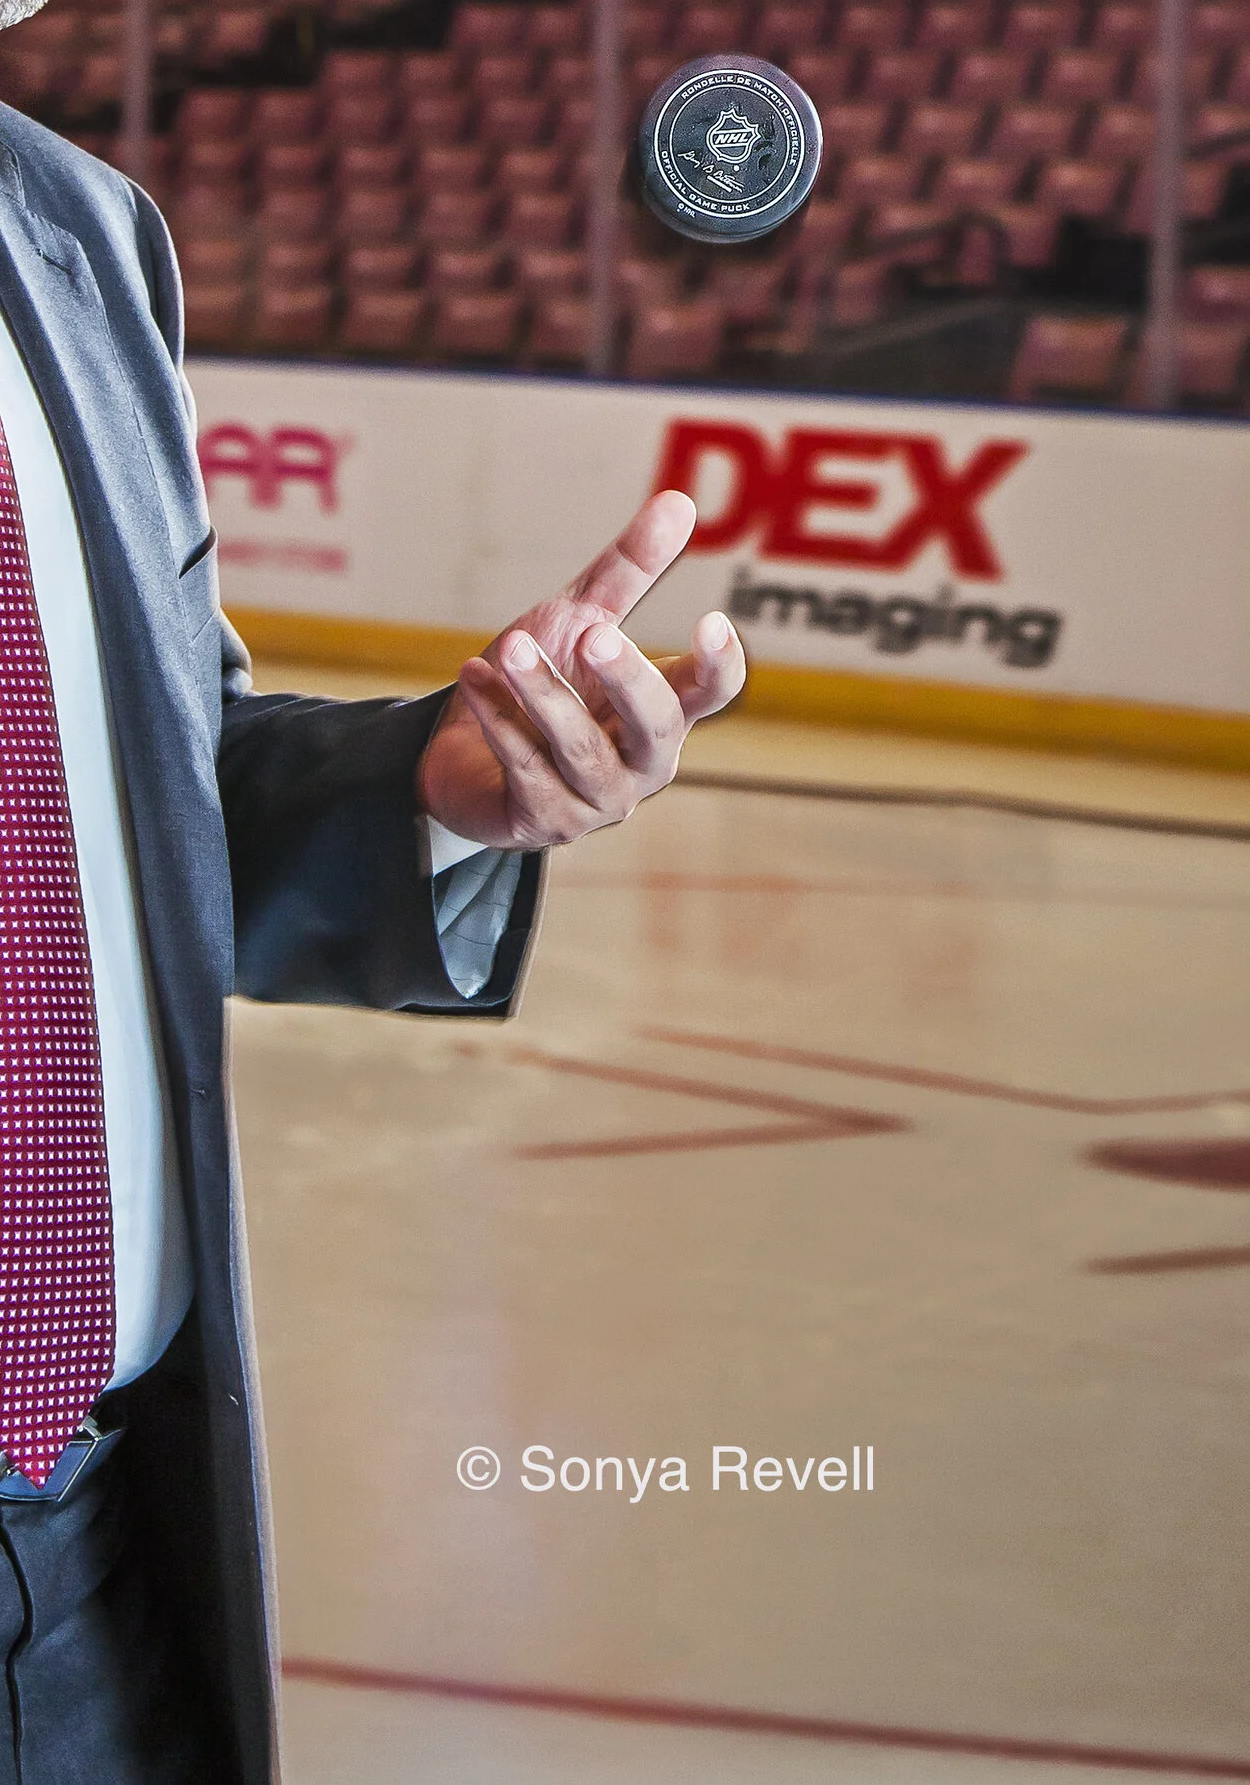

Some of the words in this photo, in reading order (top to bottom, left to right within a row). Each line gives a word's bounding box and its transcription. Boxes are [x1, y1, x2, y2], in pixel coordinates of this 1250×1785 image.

[681, 75, 734, 100] RONDELLE
[737, 76, 752, 86] DE
[754, 81, 784, 107] MATCH
[713, 132, 749, 145] NHL
[661, 151, 687, 195] OFFICIAL
[688, 193, 718, 210] GAME
[720, 203, 751, 212] PUCK
[652, 416, 1032, 584] DEX
[725, 564, 1064, 670] imaging
